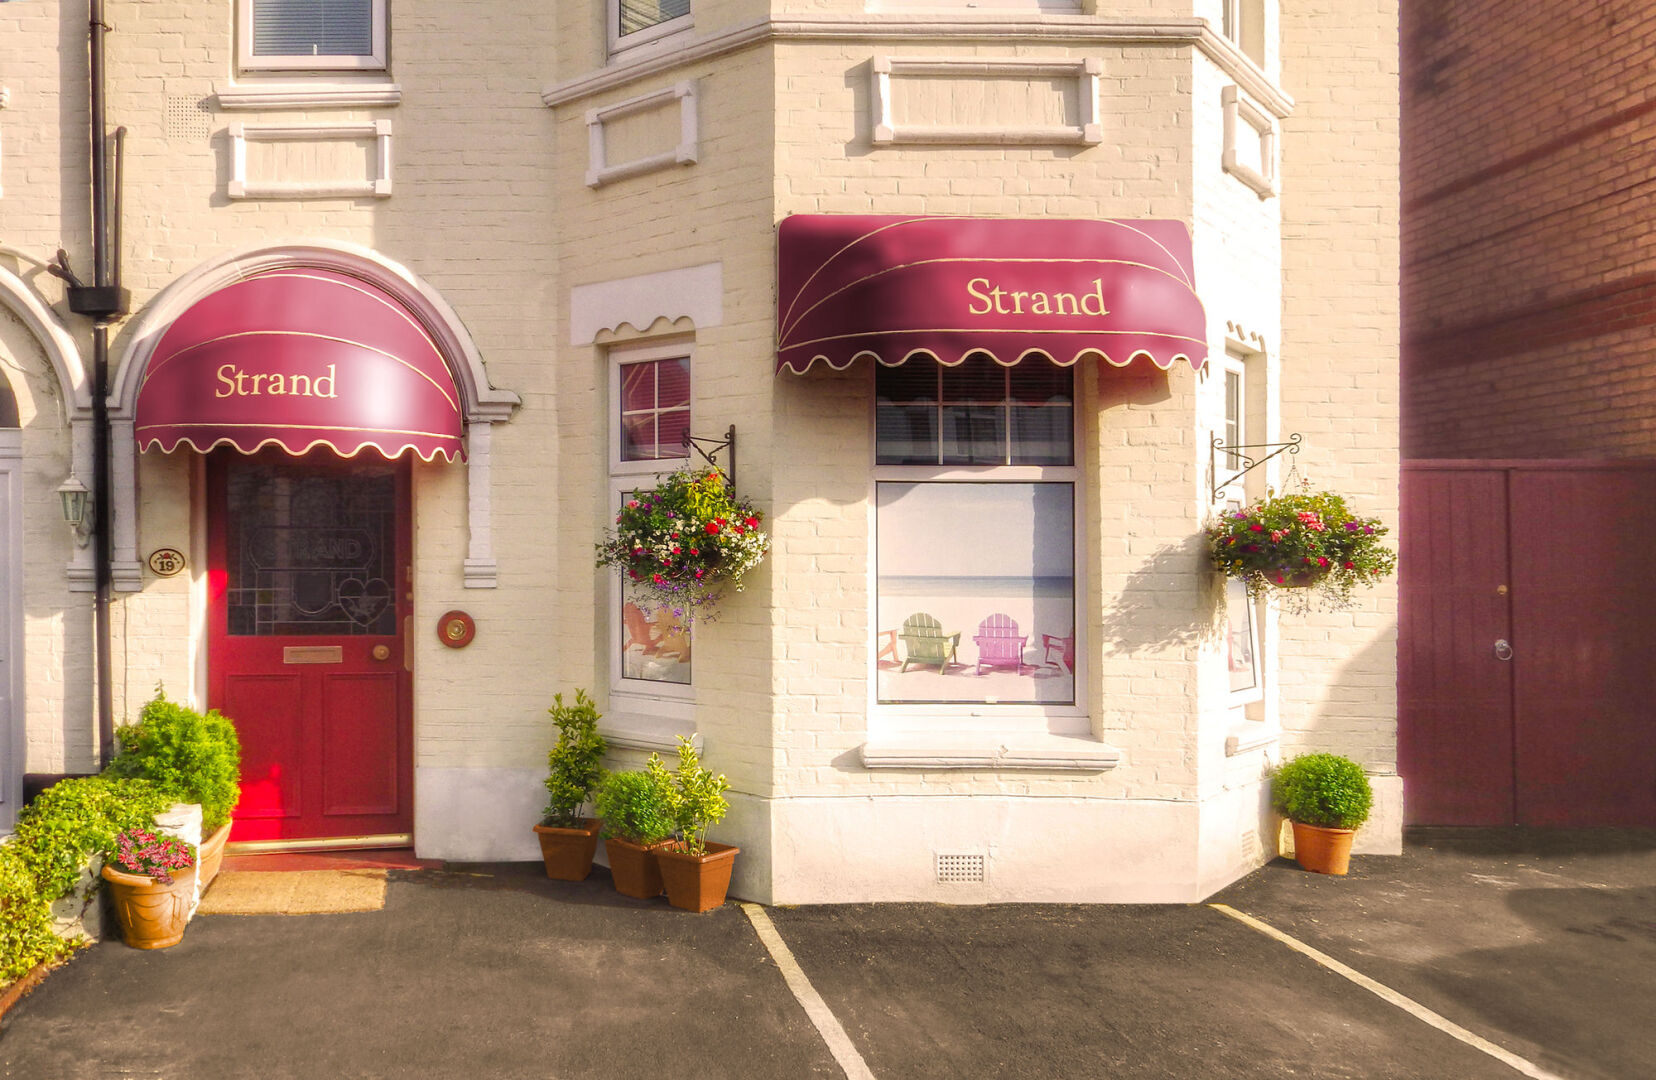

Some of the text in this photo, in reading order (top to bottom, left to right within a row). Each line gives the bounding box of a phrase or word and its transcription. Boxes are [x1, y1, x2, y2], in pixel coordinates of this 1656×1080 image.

[967, 277, 1110, 316] Strand
[215, 363, 338, 398] Strand
[159, 560, 175, 571] 19
